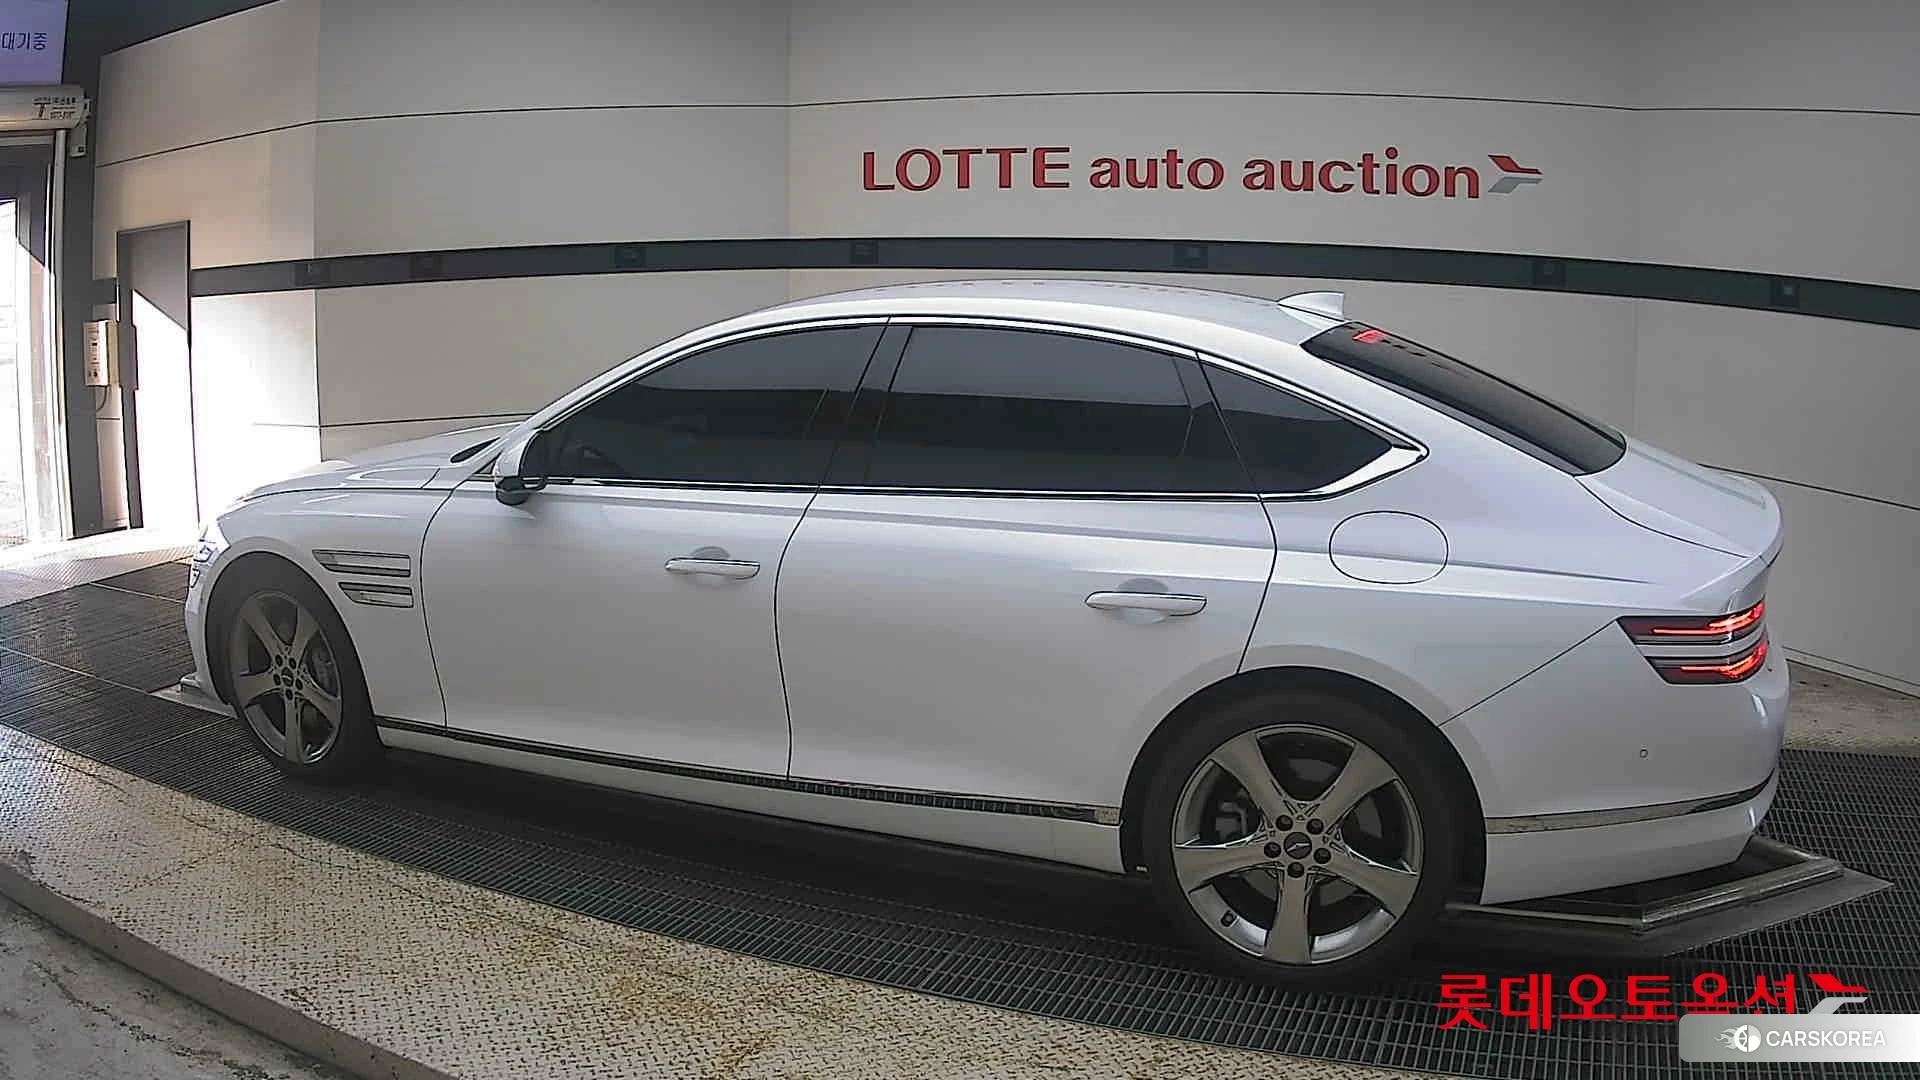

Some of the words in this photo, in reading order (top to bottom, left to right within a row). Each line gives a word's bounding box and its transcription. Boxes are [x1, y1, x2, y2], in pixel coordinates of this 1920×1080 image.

[1, 32, 48, 50] 대기중
[862, 146, 1071, 191] LOTTE
[1089, 149, 1225, 190] auto
[1243, 148, 1480, 199] auction
